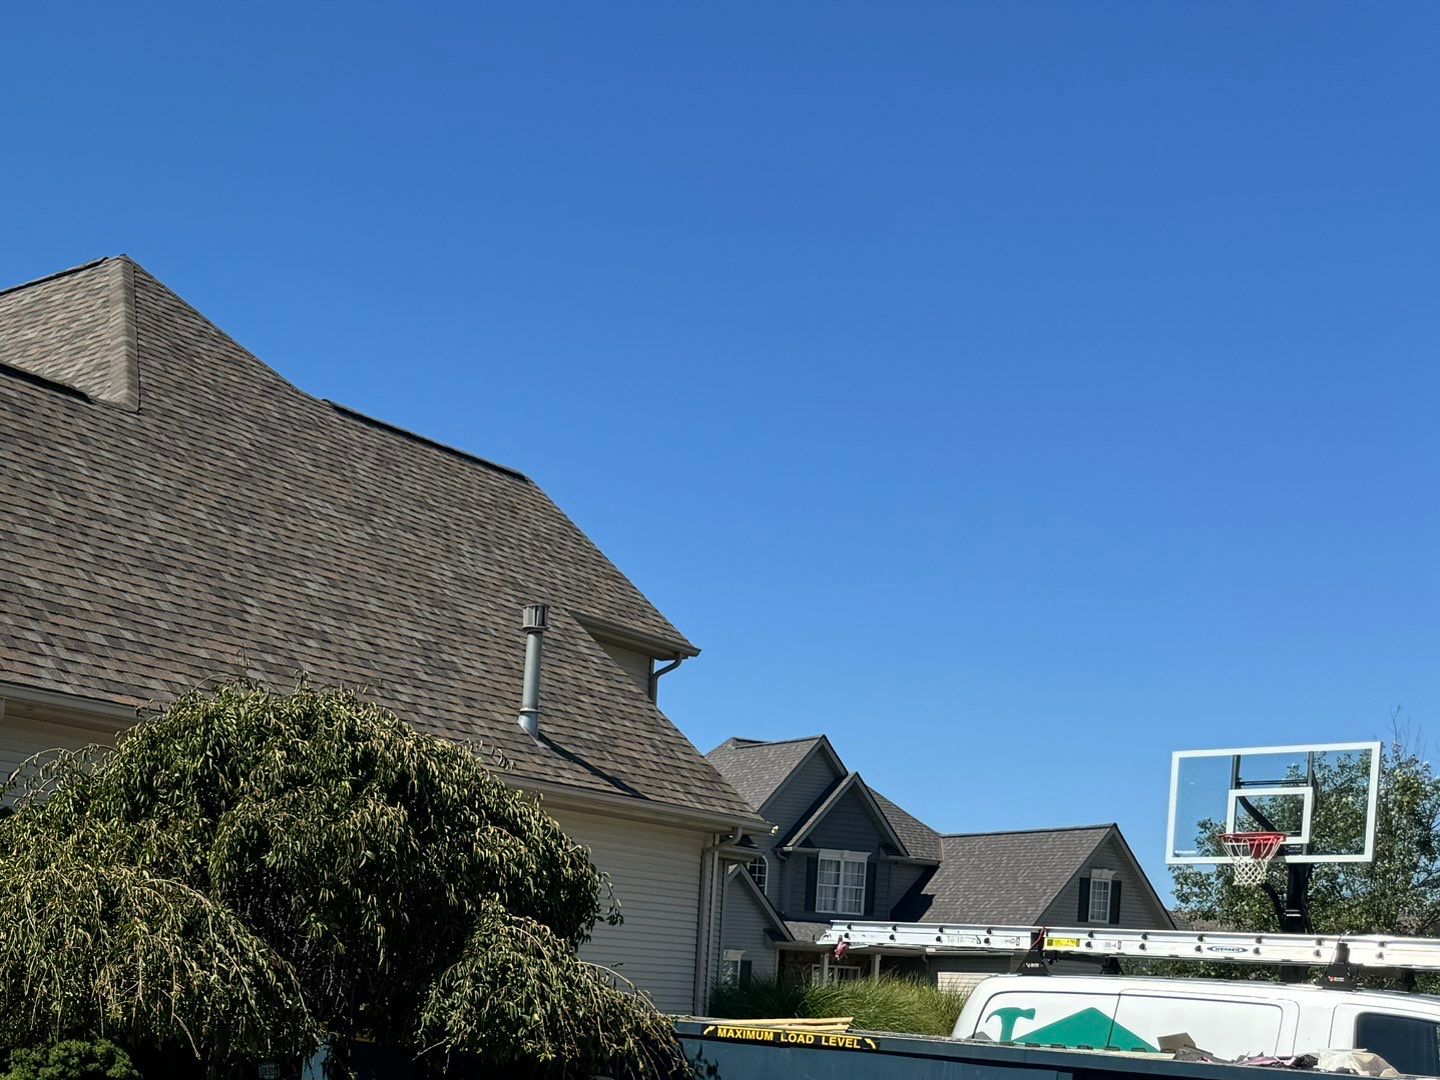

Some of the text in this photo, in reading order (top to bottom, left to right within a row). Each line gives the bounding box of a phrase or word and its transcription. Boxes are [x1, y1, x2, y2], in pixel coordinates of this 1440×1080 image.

[717, 1027, 861, 1049] MAXIMUM LOAD LEVEL
